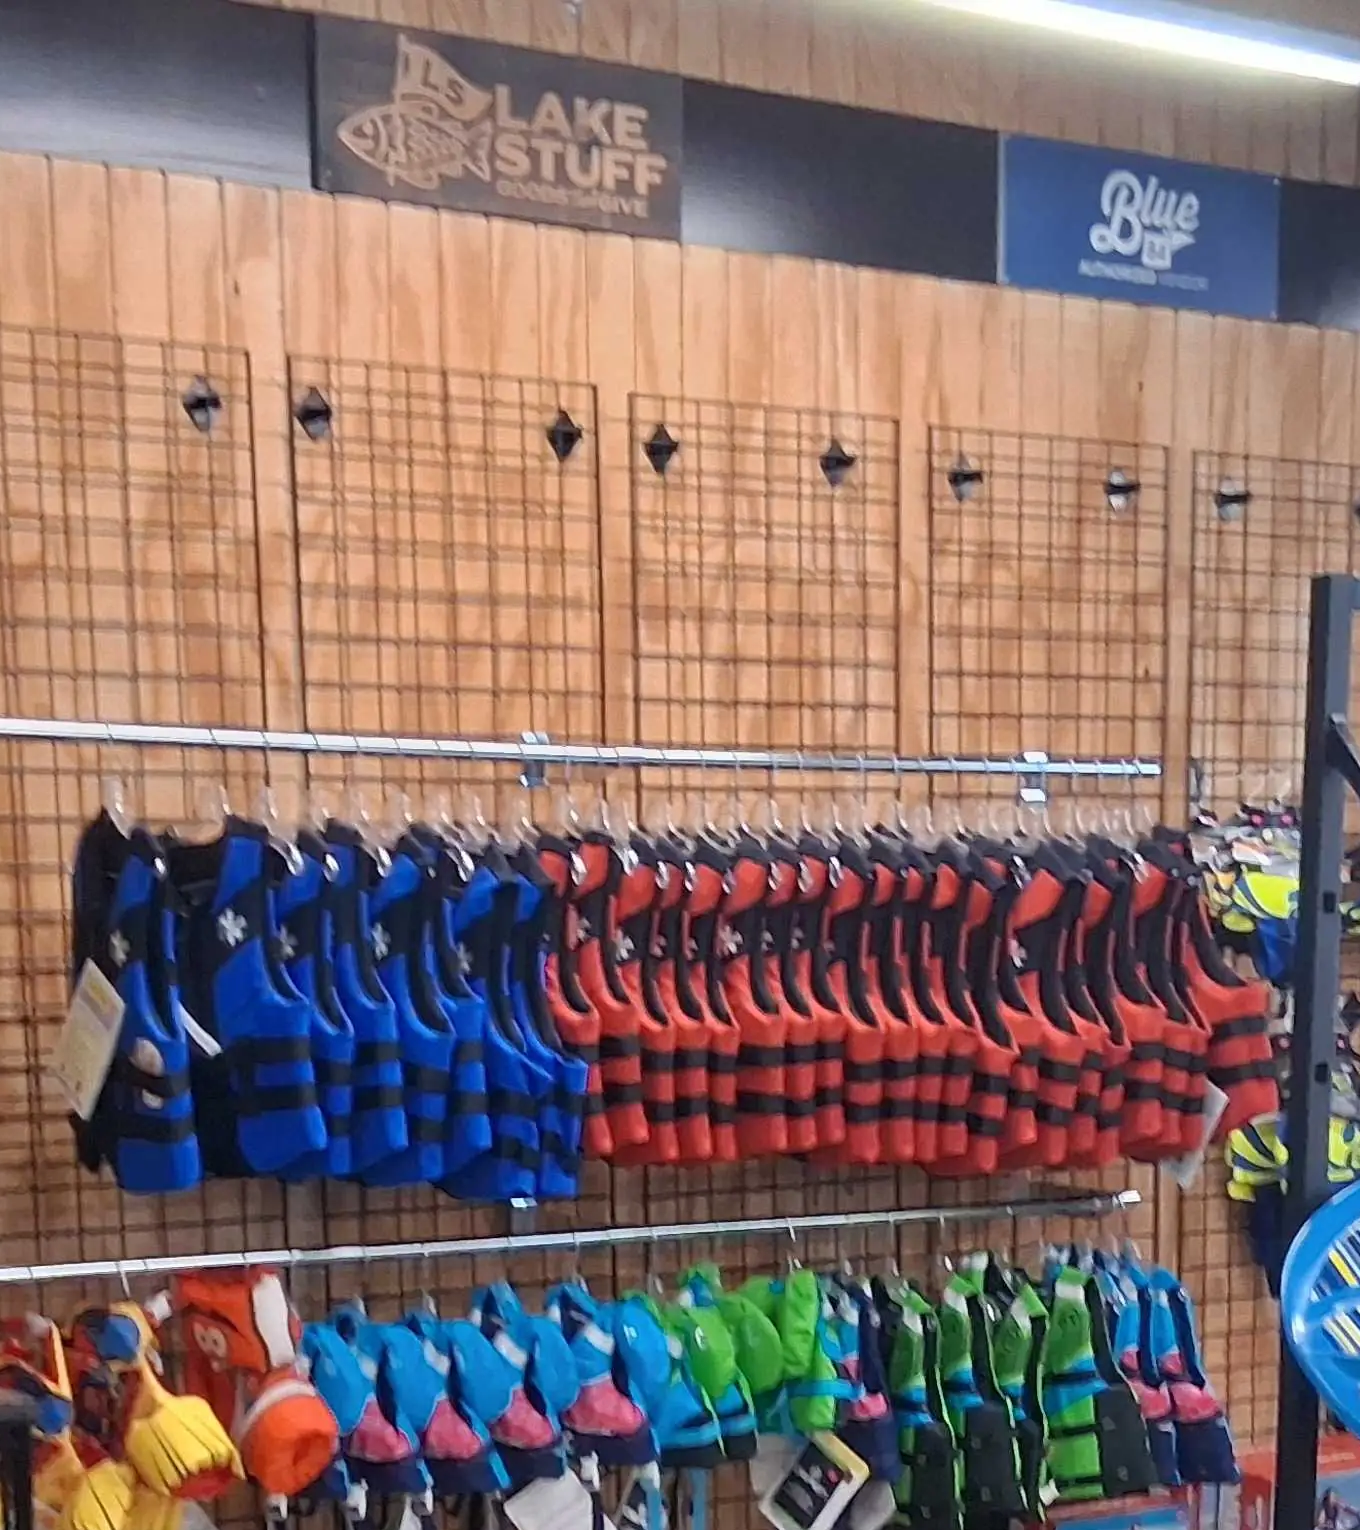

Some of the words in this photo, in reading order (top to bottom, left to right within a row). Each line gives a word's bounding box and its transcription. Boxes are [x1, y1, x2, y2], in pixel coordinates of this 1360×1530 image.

[493, 83, 649, 150] LAKE
[493, 131, 668, 196] STUFF
[1090, 169, 1200, 256] Blue
